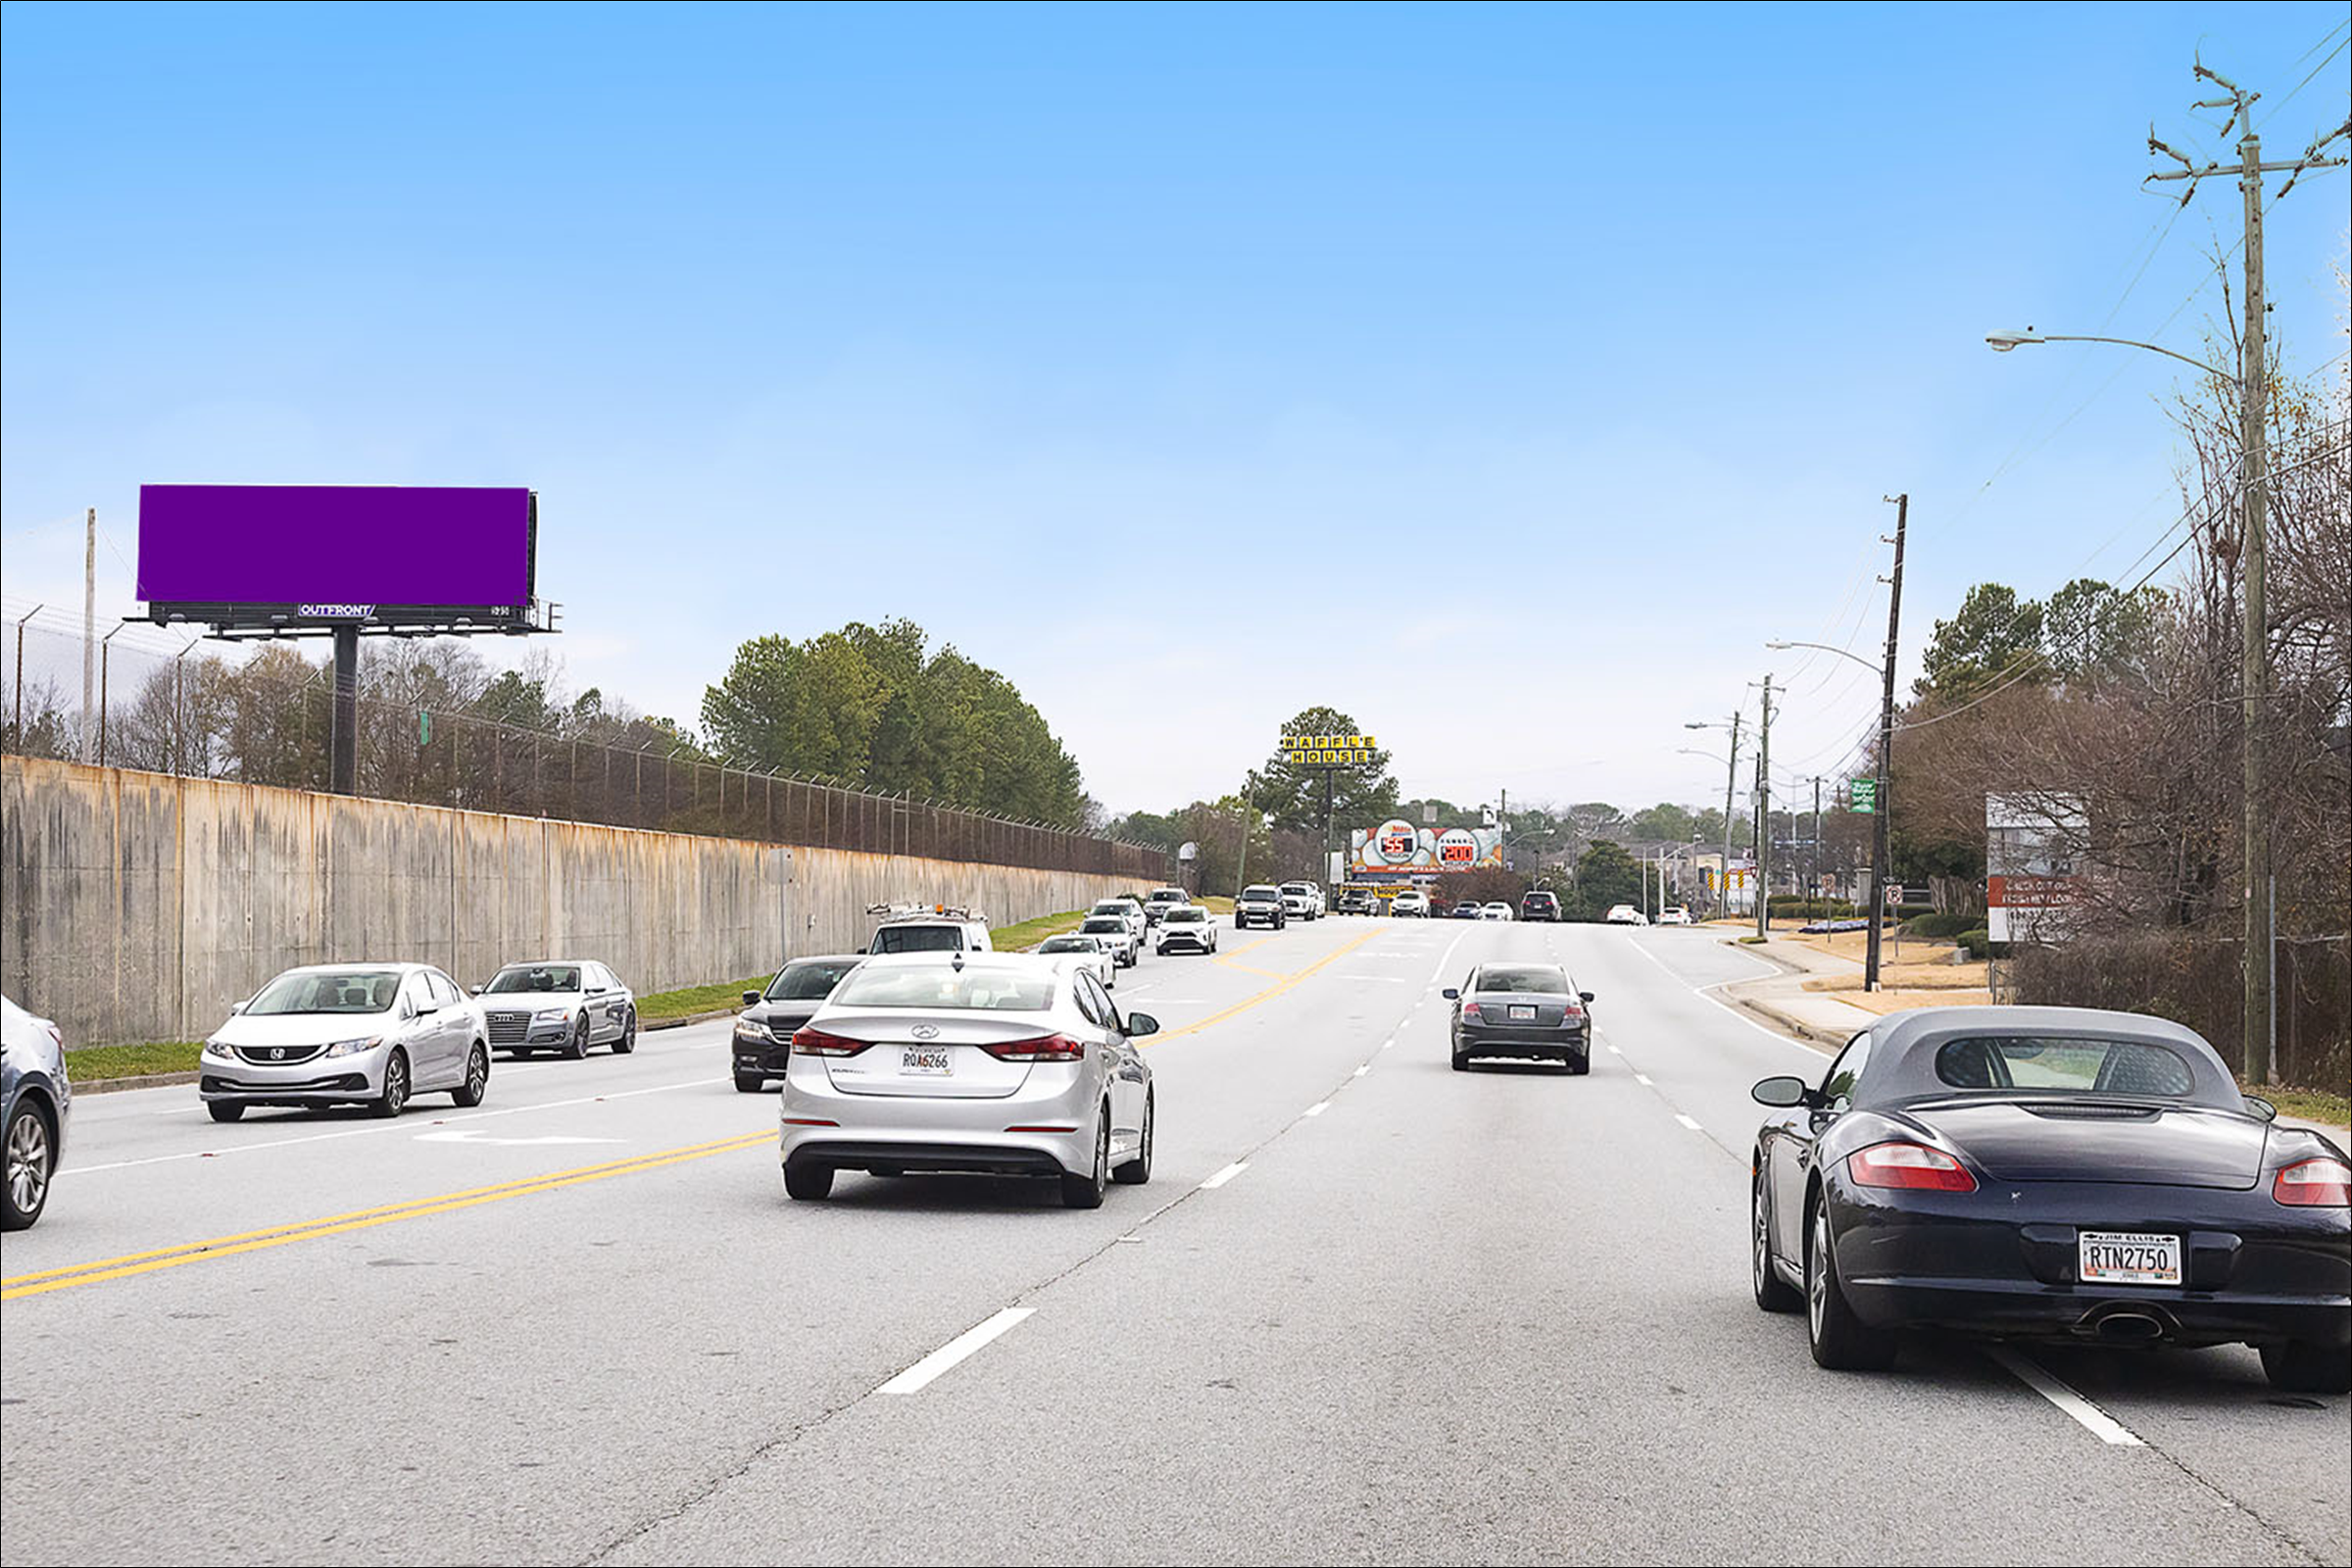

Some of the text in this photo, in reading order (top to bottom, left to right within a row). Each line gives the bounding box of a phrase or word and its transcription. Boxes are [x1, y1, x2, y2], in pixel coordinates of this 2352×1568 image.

[1284, 737, 1374, 748] WAFFLE
[1294, 751, 1366, 762] HOUSE
[2089, 1246, 2169, 1271] RTN2750
